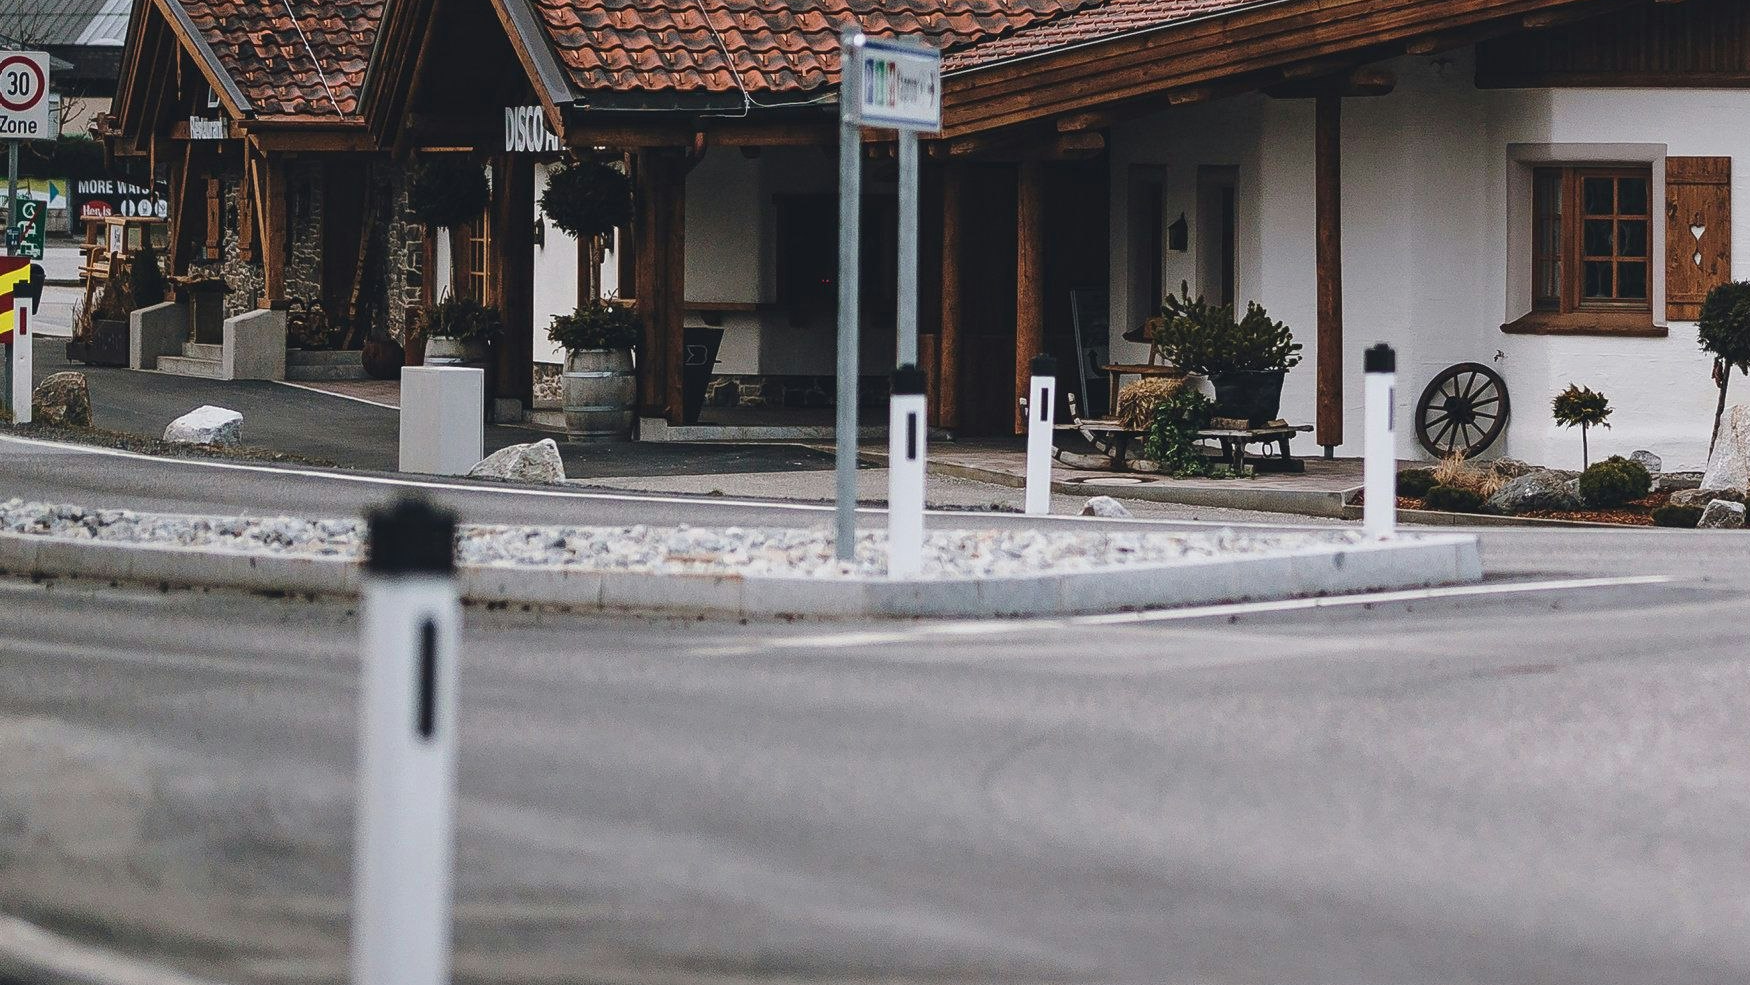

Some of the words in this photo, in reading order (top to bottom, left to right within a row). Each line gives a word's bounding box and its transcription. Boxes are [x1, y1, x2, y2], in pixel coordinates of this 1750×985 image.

[7, 71, 30, 96] 30
[0, 115, 37, 134] Zone
[505, 105, 544, 152] DISCO
[78, 179, 114, 194] MORE
